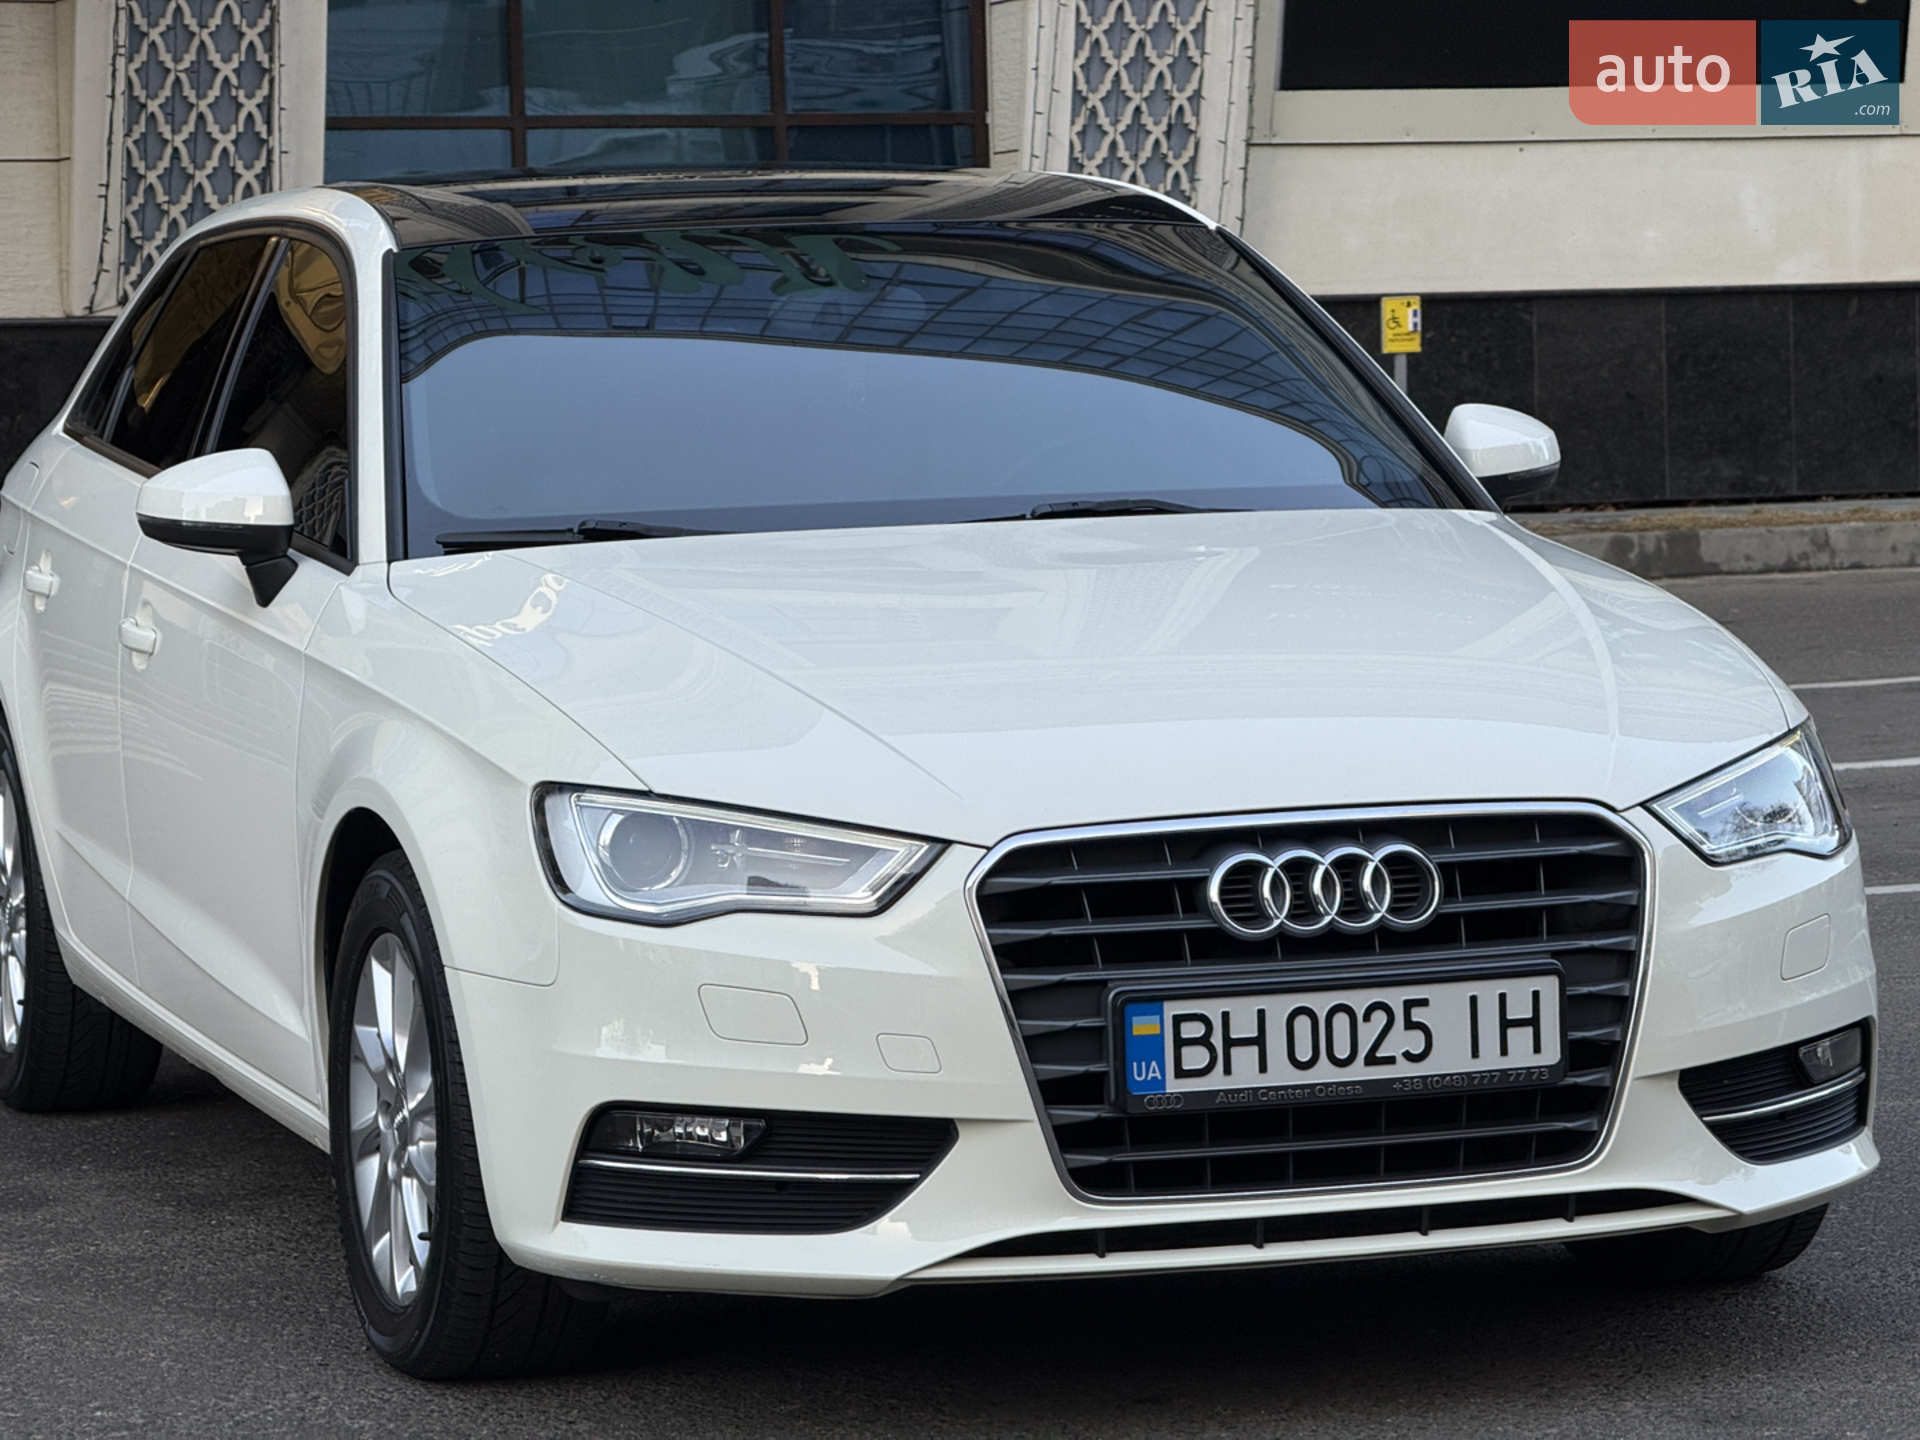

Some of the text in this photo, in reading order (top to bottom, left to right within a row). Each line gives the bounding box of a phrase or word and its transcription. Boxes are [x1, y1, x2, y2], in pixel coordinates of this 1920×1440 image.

[1171, 988, 1542, 1079] BH 0025 IH
[1132, 1060, 1162, 1082] UA
[1392, 1068, 1550, 1091] +38 (048) 777 77 73
[1215, 1084, 1364, 1104] Audi Center Odesa
